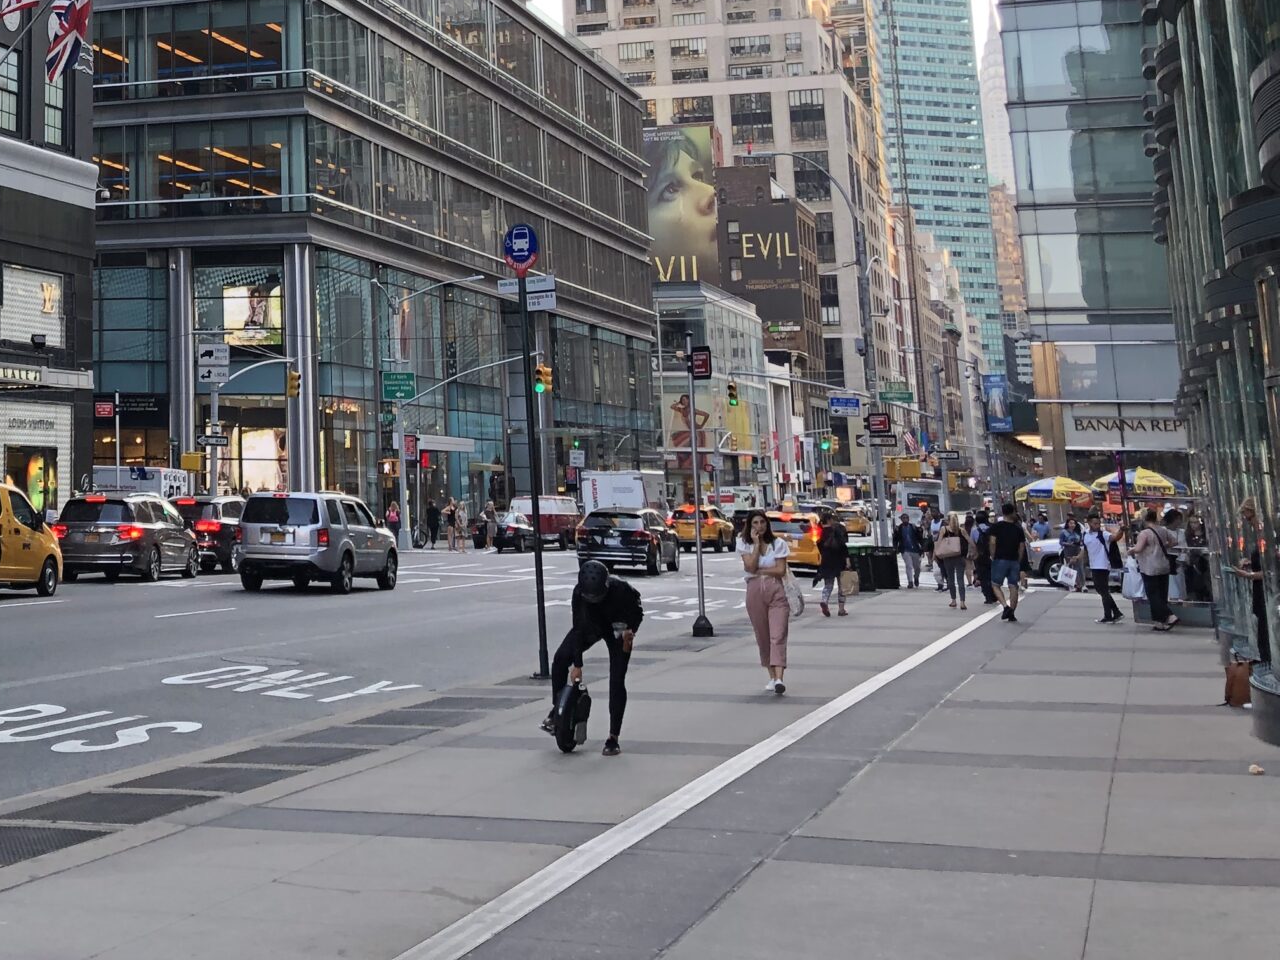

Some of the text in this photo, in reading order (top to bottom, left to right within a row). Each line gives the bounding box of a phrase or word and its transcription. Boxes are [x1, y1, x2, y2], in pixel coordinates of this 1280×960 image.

[742, 232, 797, 259] EVIL
[1074, 418, 1147, 431] BANANA
[160, 665, 423, 703] ONLY
